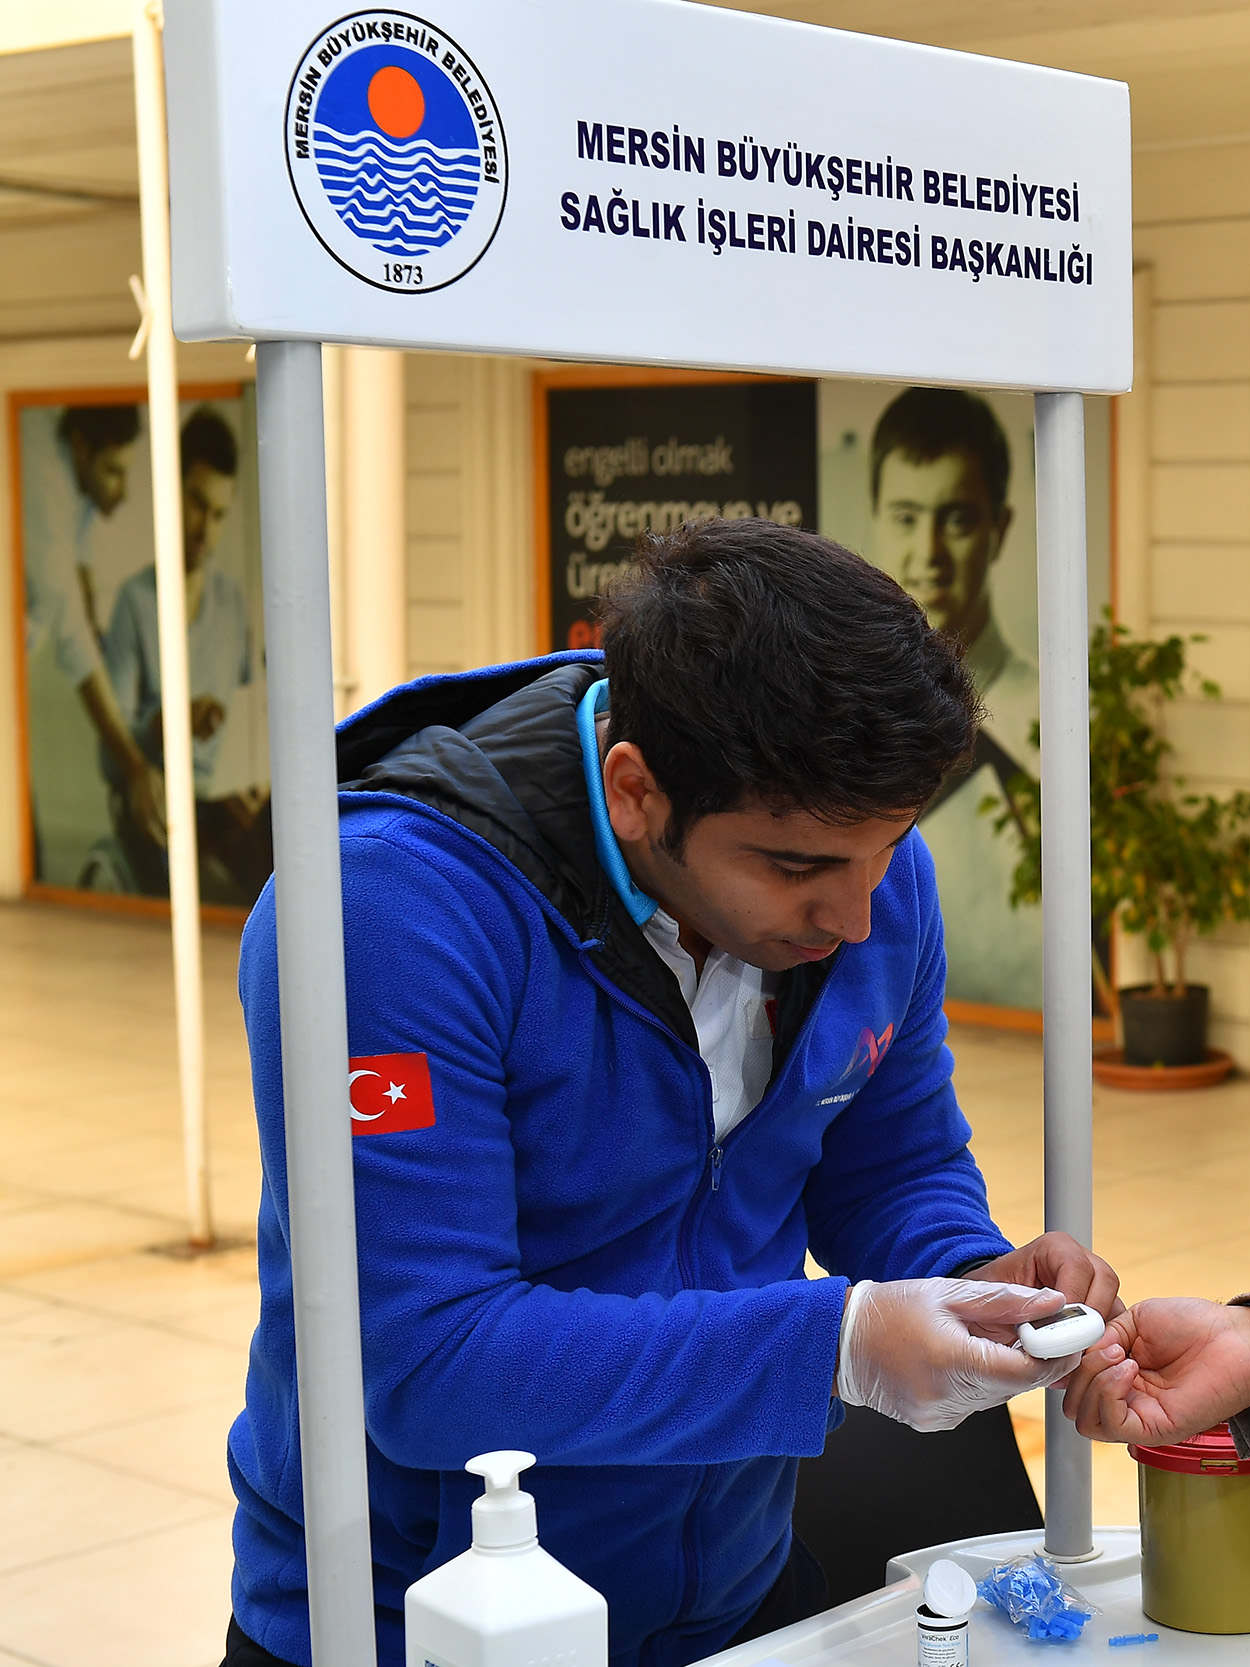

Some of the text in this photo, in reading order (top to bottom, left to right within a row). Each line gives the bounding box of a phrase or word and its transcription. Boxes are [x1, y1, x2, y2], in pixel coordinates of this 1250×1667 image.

[295, 21, 500, 184] MERSİN BÜYÜKŞEHİR BELEDİYESİ
[576, 120, 1080, 223] MERSİN BÜYÜKŞEHİR BELEDİYESİ
[382, 262, 424, 285] 1873
[560, 187, 1093, 286] SAĞLIK İŞLERİ DAİRESİ BAŞKANLIĞI
[564, 434, 735, 487] engelli olmak
